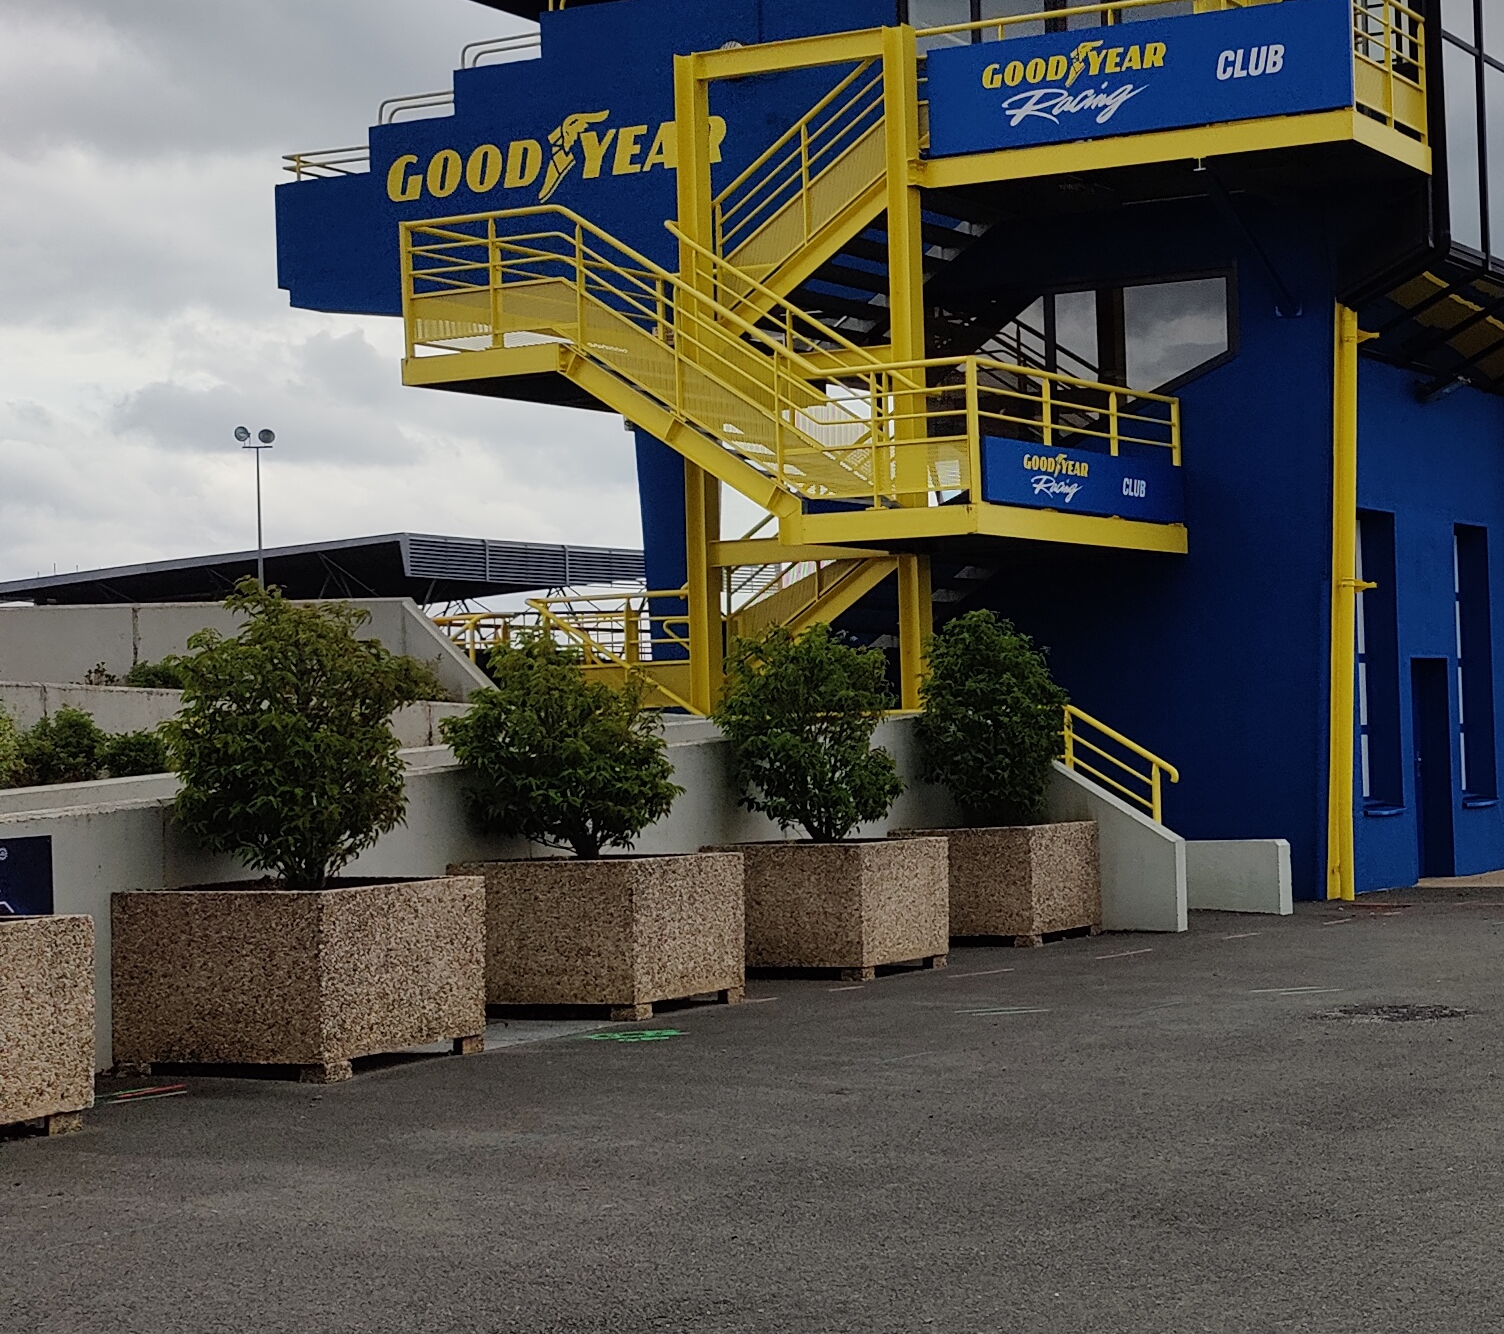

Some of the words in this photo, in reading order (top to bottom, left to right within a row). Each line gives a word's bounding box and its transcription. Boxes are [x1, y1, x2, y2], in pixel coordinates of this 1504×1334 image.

[982, 40, 1167, 89] GOODYEAR
[1216, 43, 1286, 81] CLUB
[1002, 82, 1149, 127] Racing
[1023, 453, 1089, 478] GOODYEAR
[1031, 475, 1083, 503] Racing
[1122, 477, 1147, 498] CLUB
